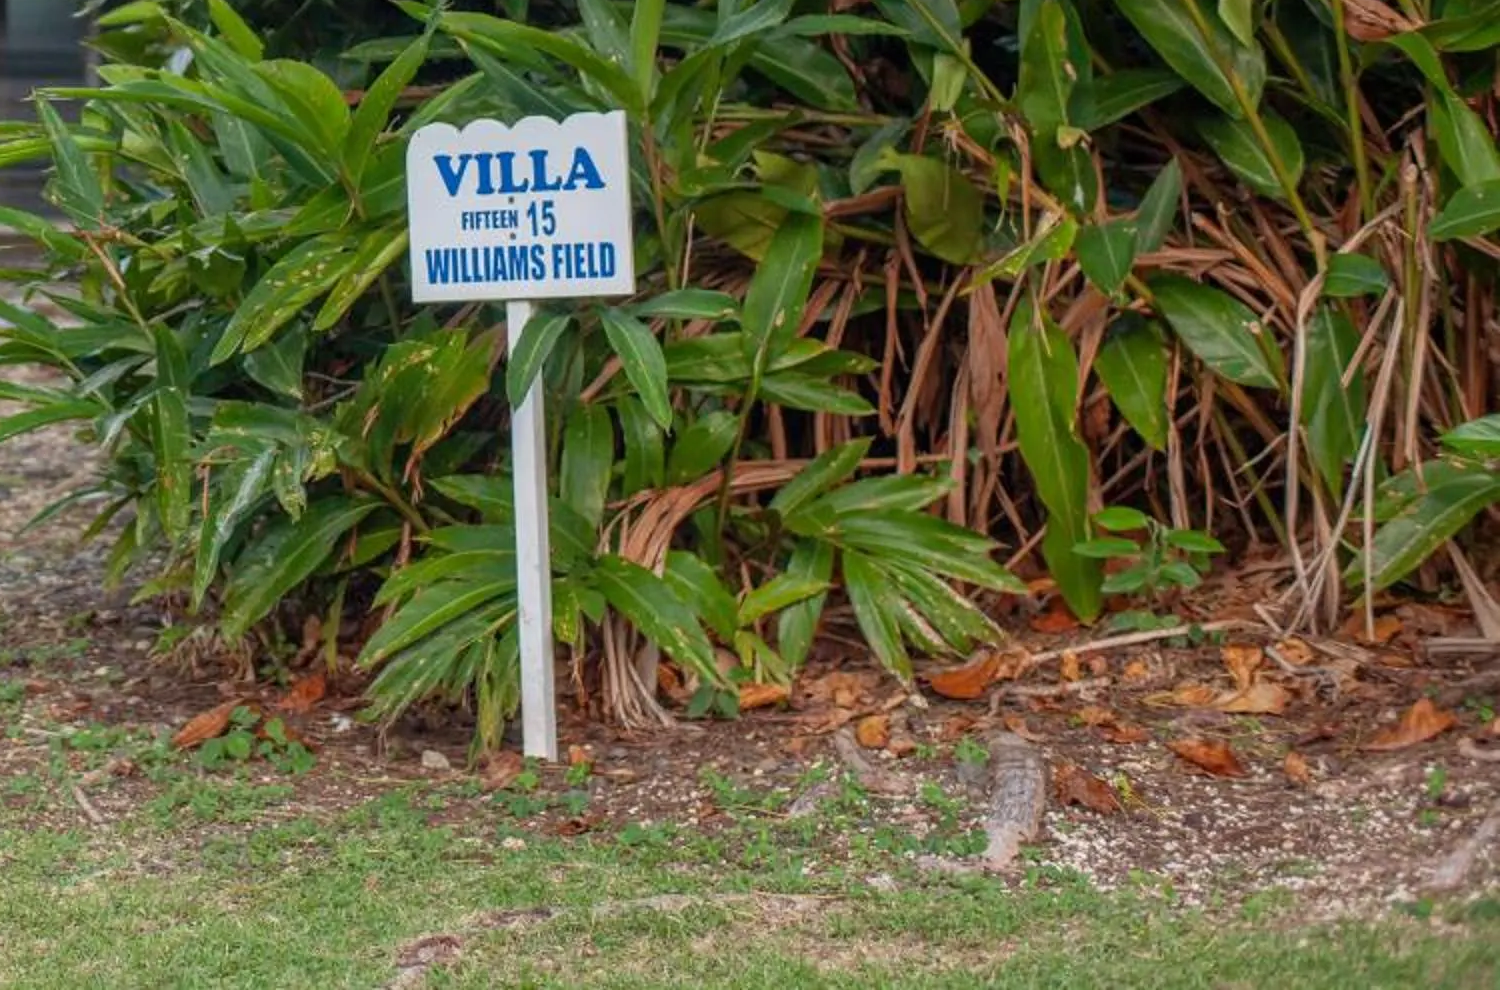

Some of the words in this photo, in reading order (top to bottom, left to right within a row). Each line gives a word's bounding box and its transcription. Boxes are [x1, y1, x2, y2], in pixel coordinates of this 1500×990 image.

[433, 146, 606, 196] VILLA
[461, 209, 519, 230] FIFTEEN
[526, 200, 556, 236] 15
[425, 244, 546, 285] WILLIAMS
[552, 242, 616, 279] FIELD
